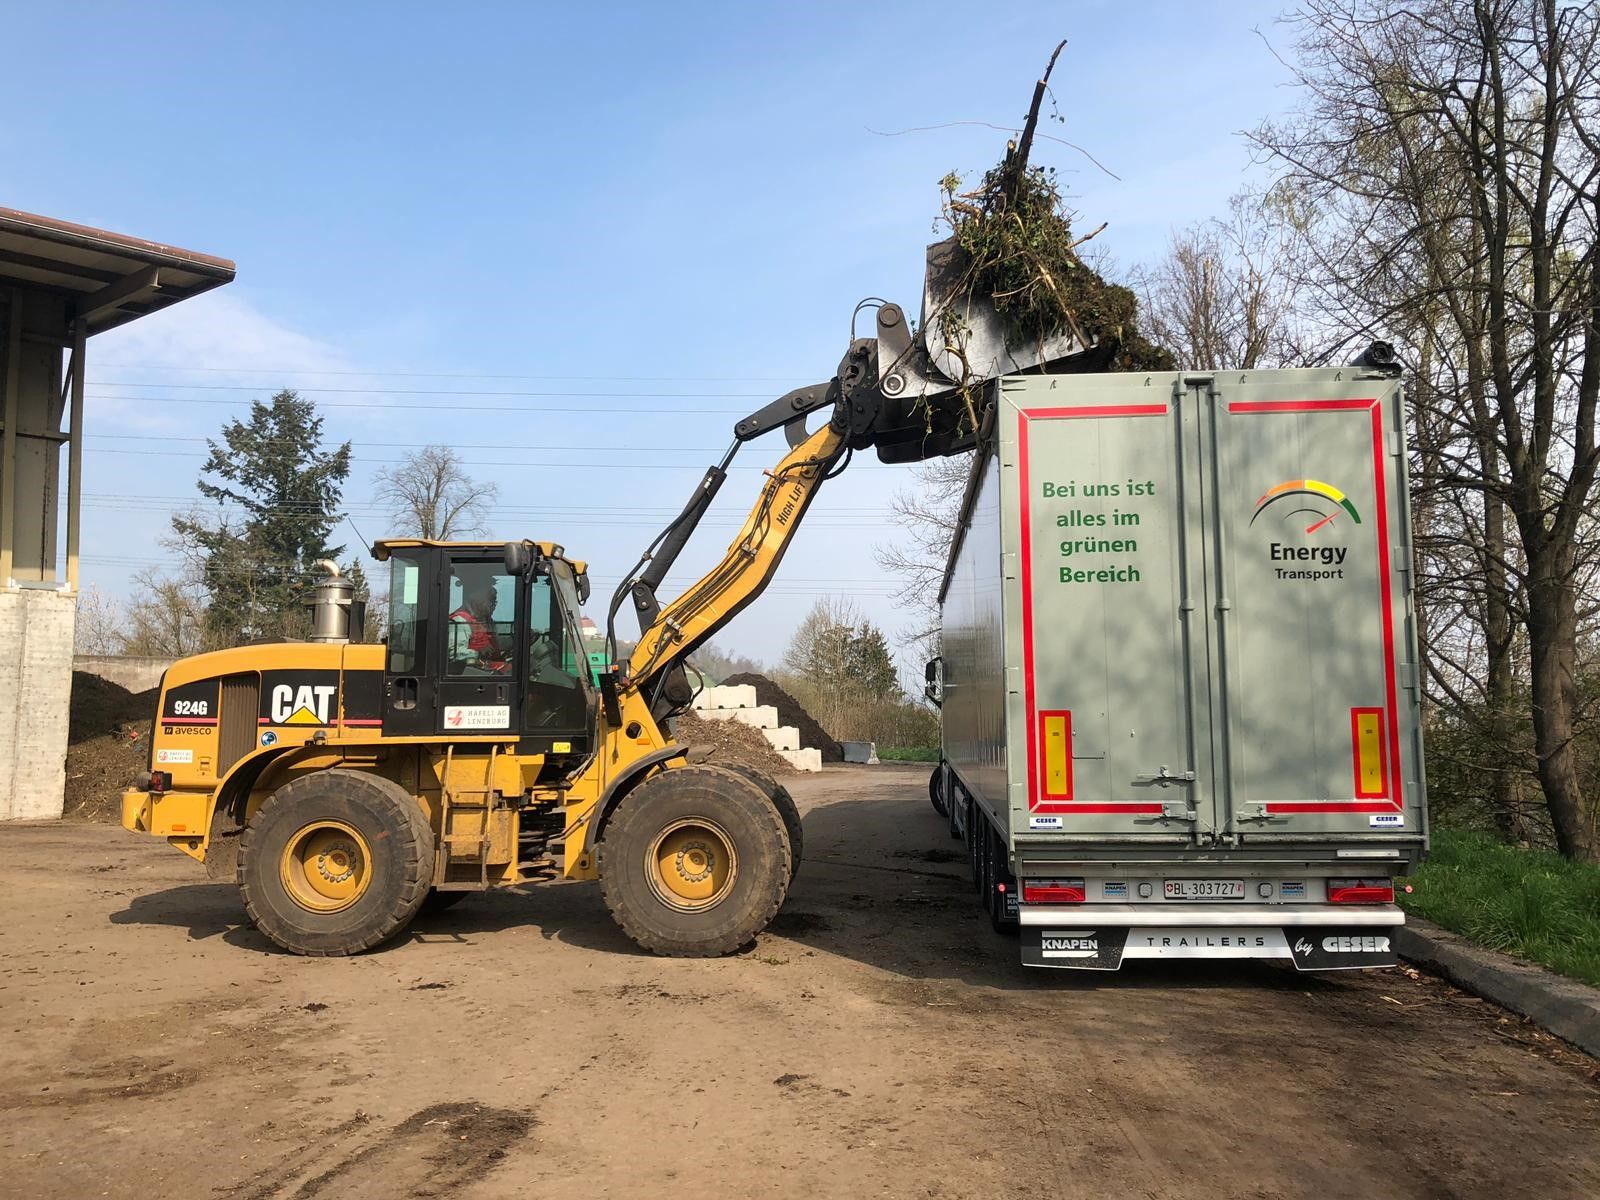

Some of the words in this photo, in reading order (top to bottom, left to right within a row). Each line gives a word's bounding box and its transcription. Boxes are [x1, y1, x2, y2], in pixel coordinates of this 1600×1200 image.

[1042, 480, 1076, 498] Bei
[1083, 483, 1120, 497] uns
[1126, 479, 1155, 496] ist
[776, 502, 795, 526] HIGH
[788, 480, 806, 503] LIFT
[1056, 510, 1106, 527] alles
[1112, 509, 1140, 526] im
[1060, 537, 1137, 557] grünen
[1270, 543, 1348, 565] Energy
[1059, 565, 1140, 583] Bereich
[1275, 568, 1344, 581] Transport
[174, 700, 208, 715] 924G
[271, 684, 336, 724] CAT
[174, 727, 212, 735] avesco
[1041, 939, 1099, 950] KNAPEN
[1146, 936, 1265, 947] TRAILERS
[1295, 936, 1314, 957] by
[1321, 936, 1391, 953] GESER
